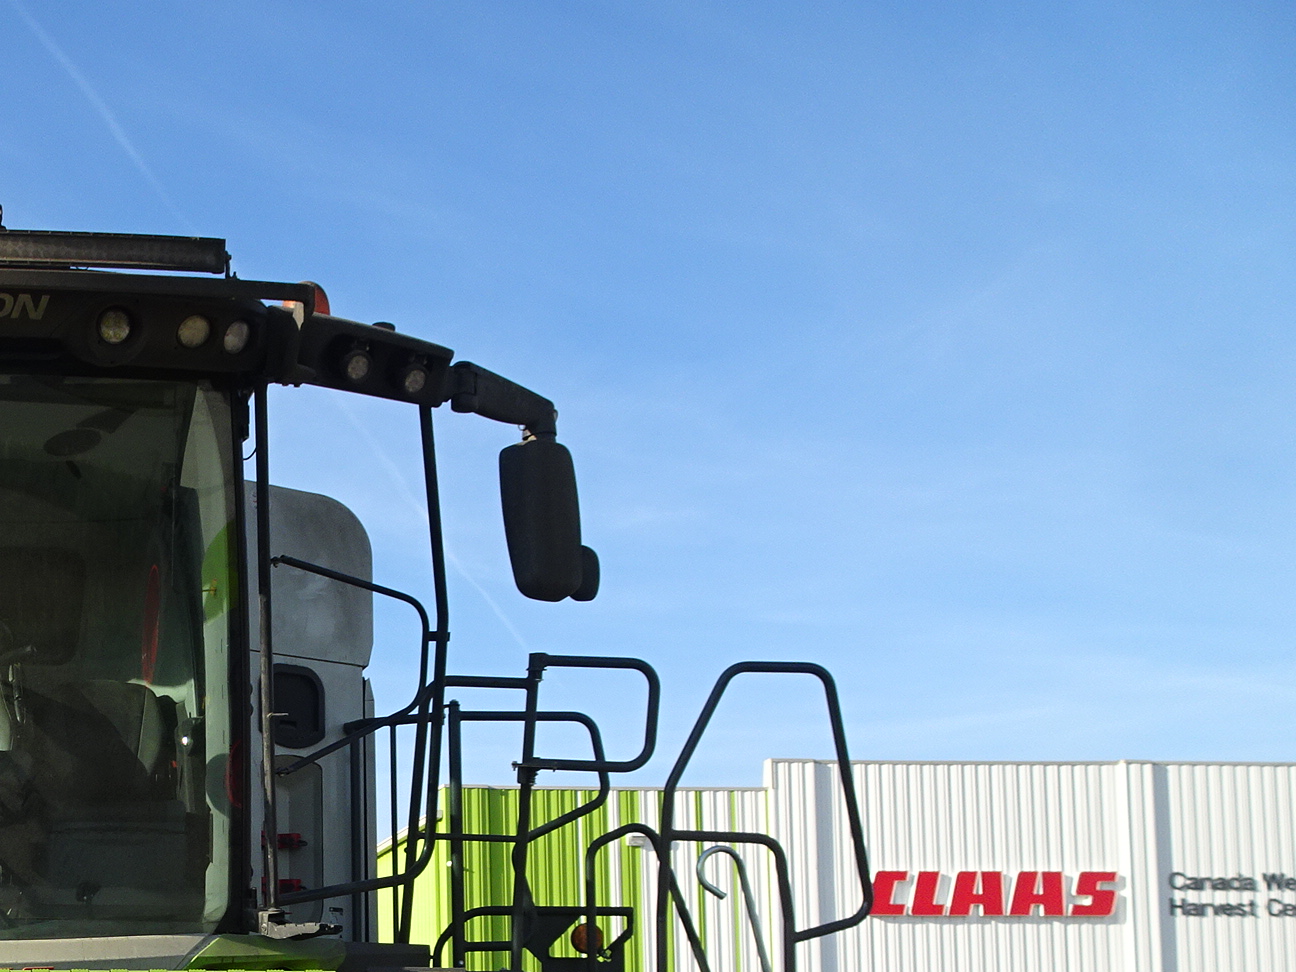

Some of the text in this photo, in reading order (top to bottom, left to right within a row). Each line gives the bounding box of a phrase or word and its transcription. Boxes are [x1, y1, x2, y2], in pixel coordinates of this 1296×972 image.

[1169, 871, 1258, 892] Canada
[870, 870, 1119, 916] CLAAS
[1169, 898, 1260, 918] Harvest
